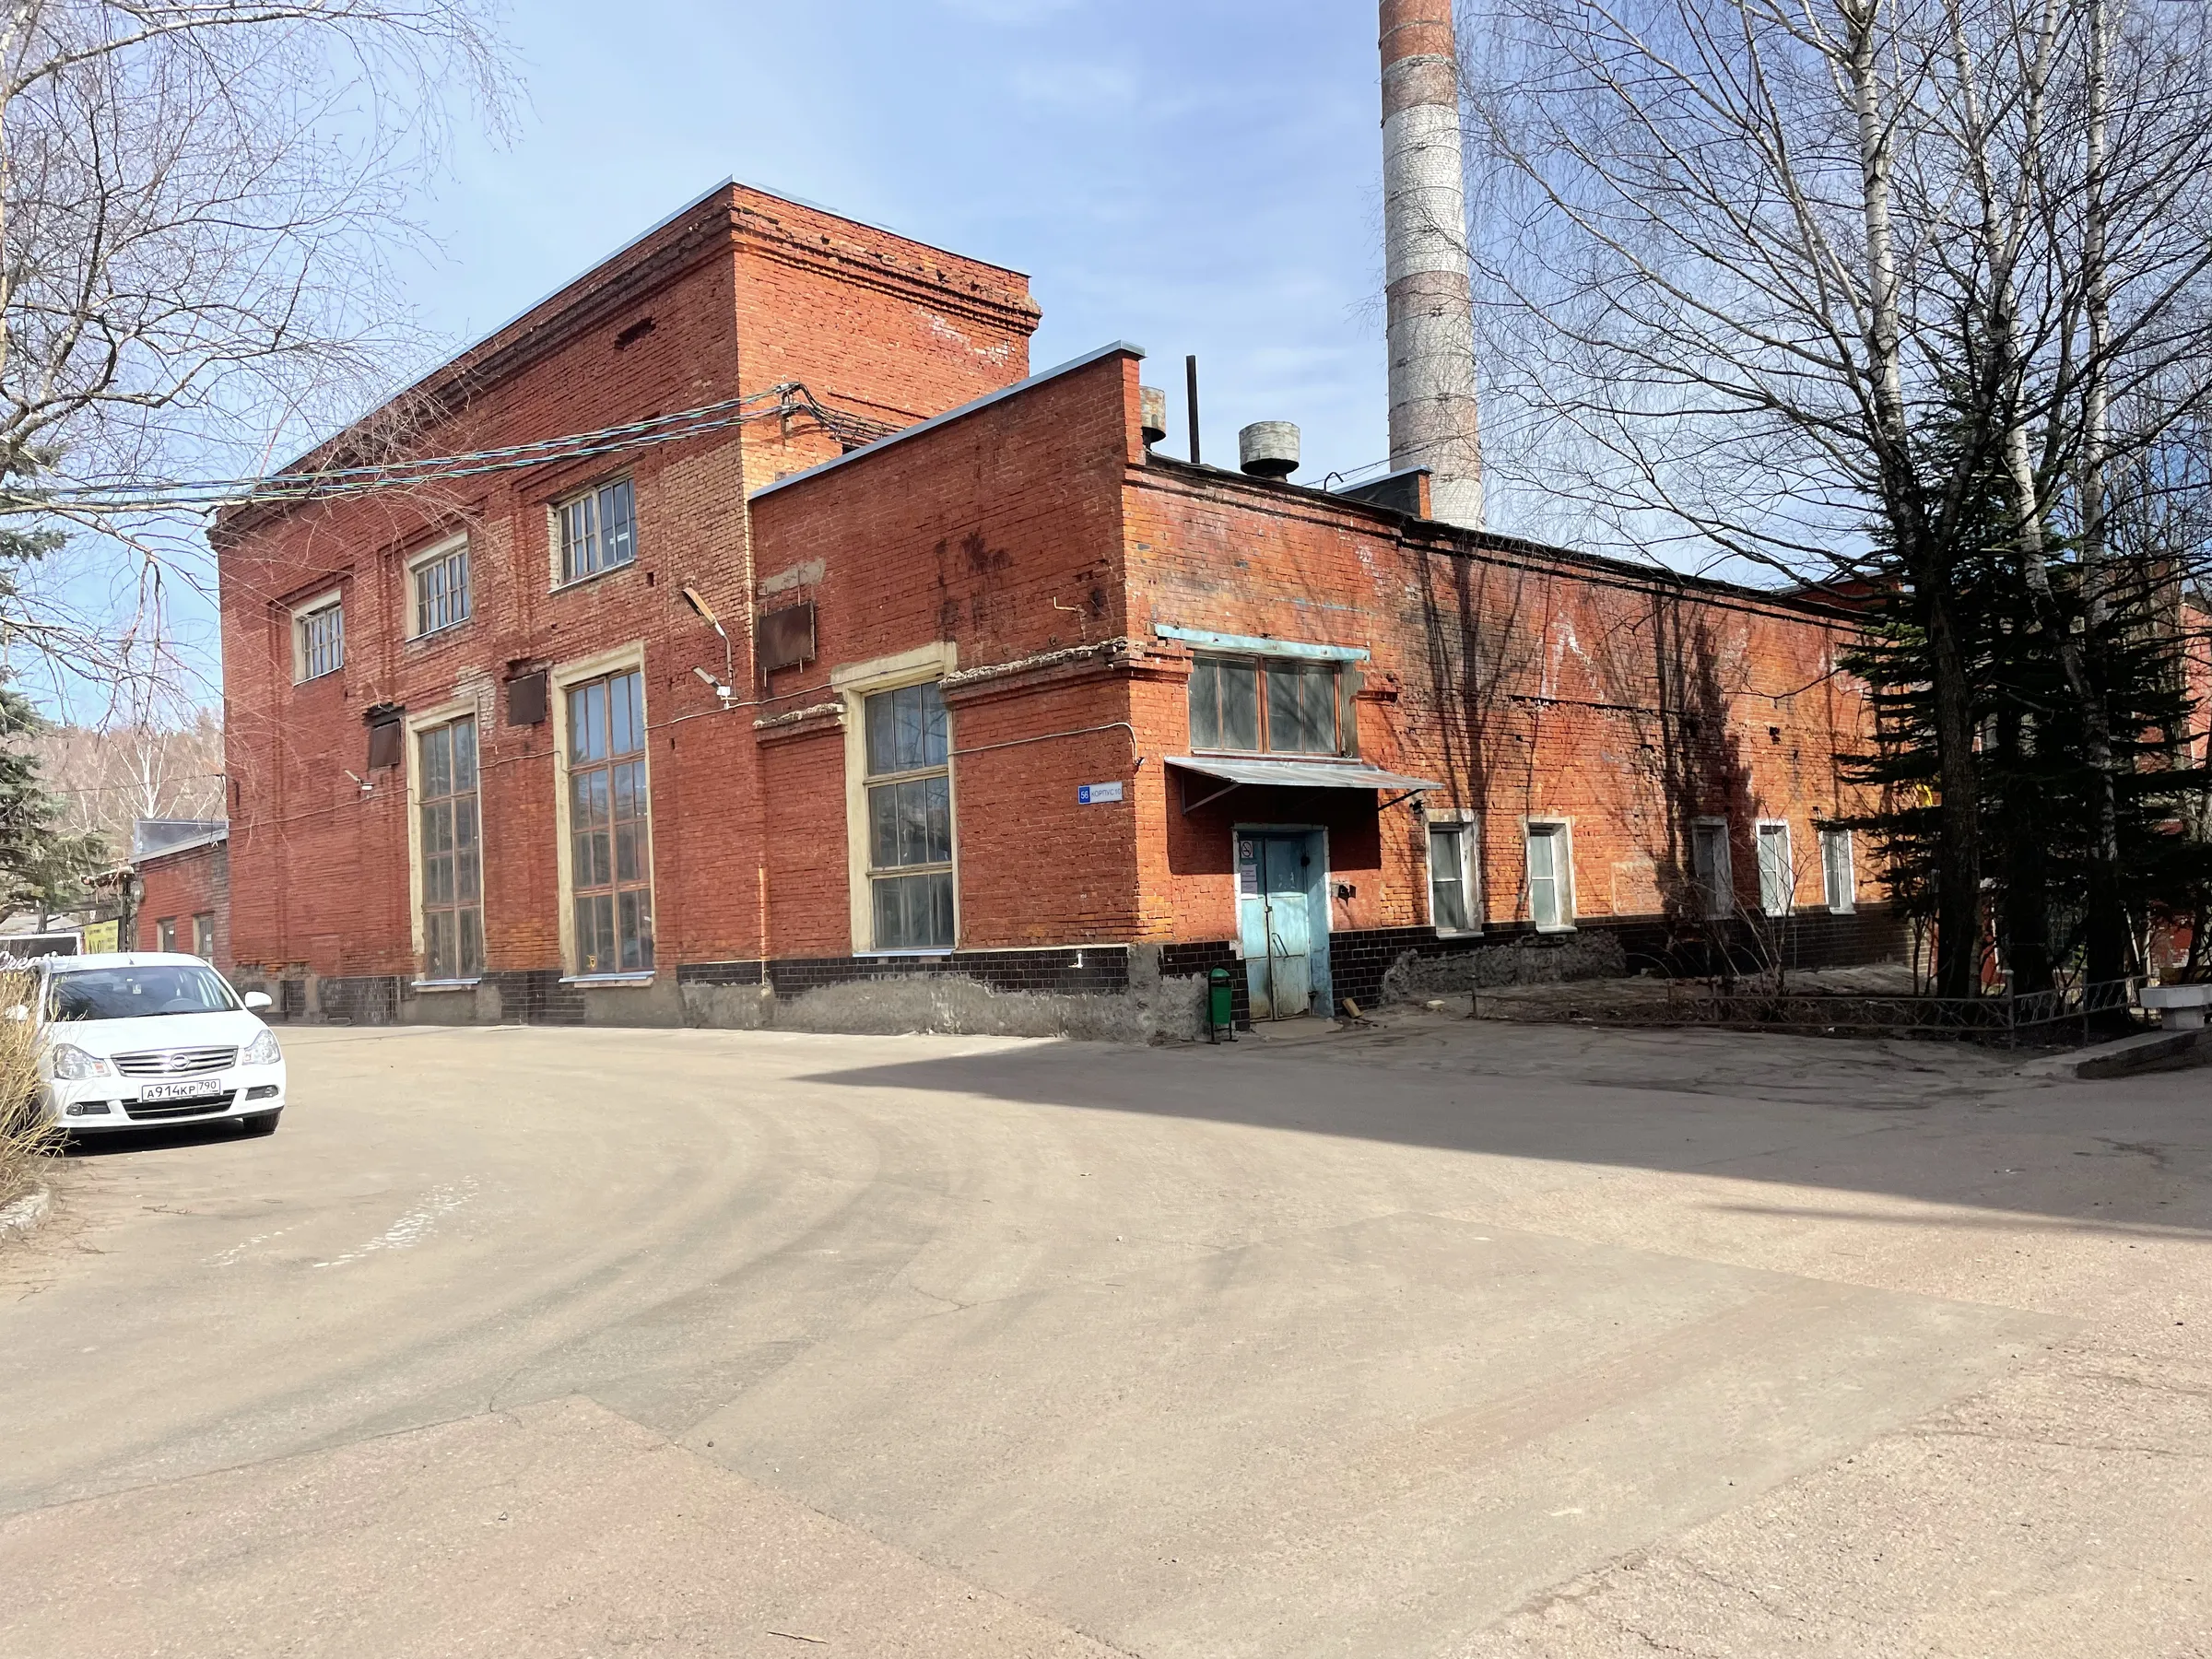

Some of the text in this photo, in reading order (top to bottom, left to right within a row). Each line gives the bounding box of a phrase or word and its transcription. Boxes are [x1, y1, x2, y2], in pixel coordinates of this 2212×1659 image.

[1080, 790, 1089, 800] 56
[1091, 789, 1114, 797] КОРПУС
[147, 1080, 218, 1099] А914КР 790
